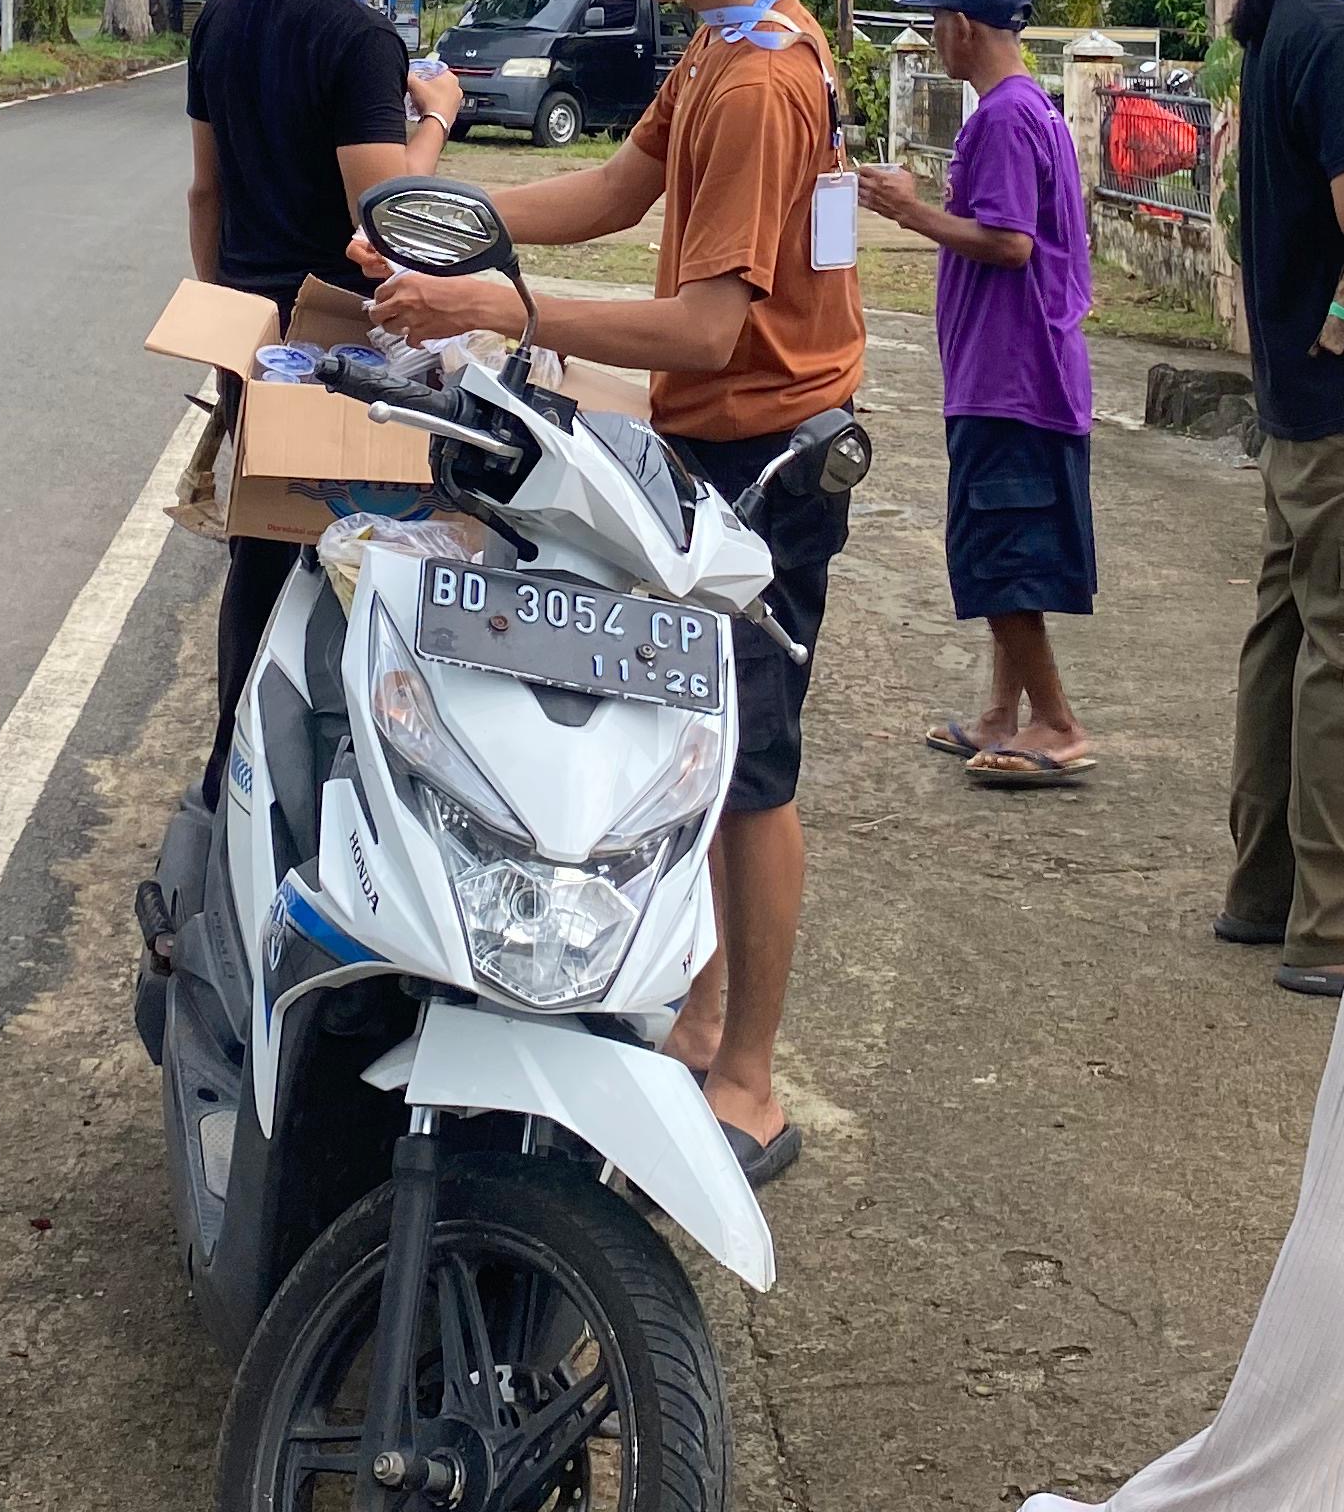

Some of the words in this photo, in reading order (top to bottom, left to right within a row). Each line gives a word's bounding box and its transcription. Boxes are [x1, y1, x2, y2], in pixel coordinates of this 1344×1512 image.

[433, 566, 487, 612] BD
[516, 584, 626, 636] 3054
[651, 611, 703, 653] CP
[348, 828, 379, 916] HONDA
